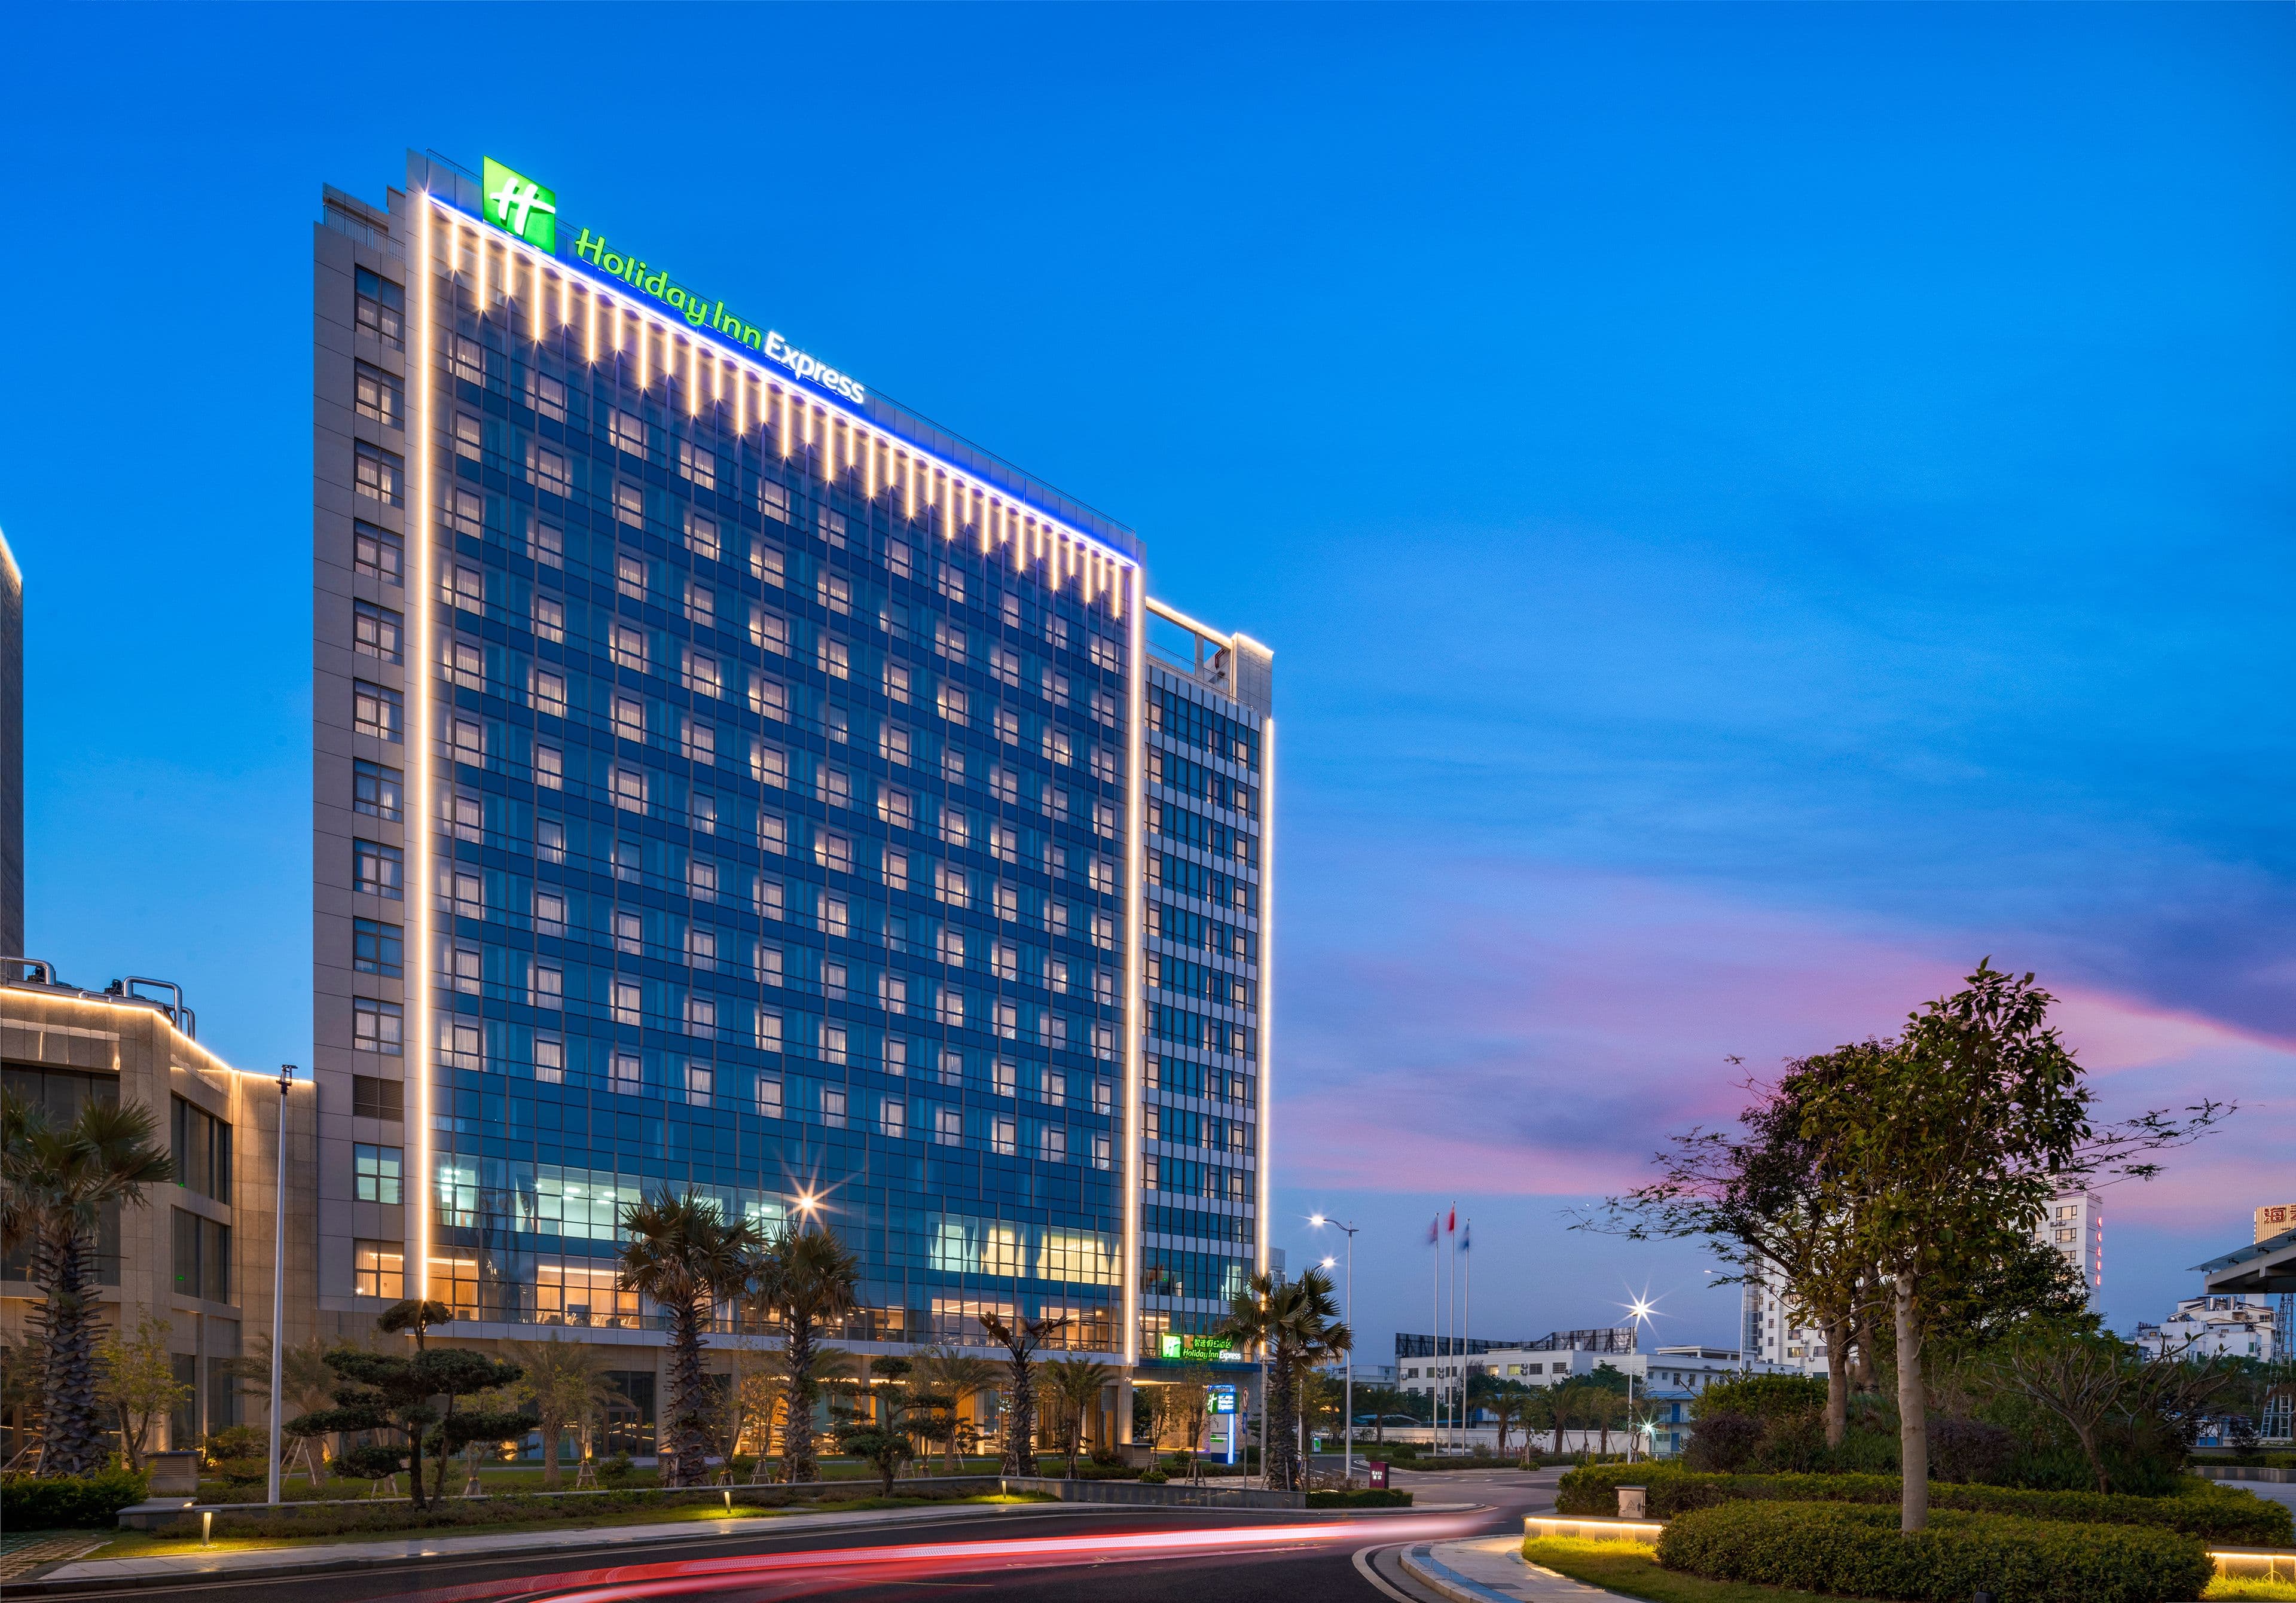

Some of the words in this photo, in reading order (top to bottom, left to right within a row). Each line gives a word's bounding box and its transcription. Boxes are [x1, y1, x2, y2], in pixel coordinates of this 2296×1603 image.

[575, 228, 709, 326] Holiday
[713, 301, 762, 350] Inn
[764, 331, 865, 405] Express
[1183, 1348, 1208, 1359] Holiday
[1208, 1349, 1219, 1358] Inn
[1219, 1351, 1241, 1360] Express
